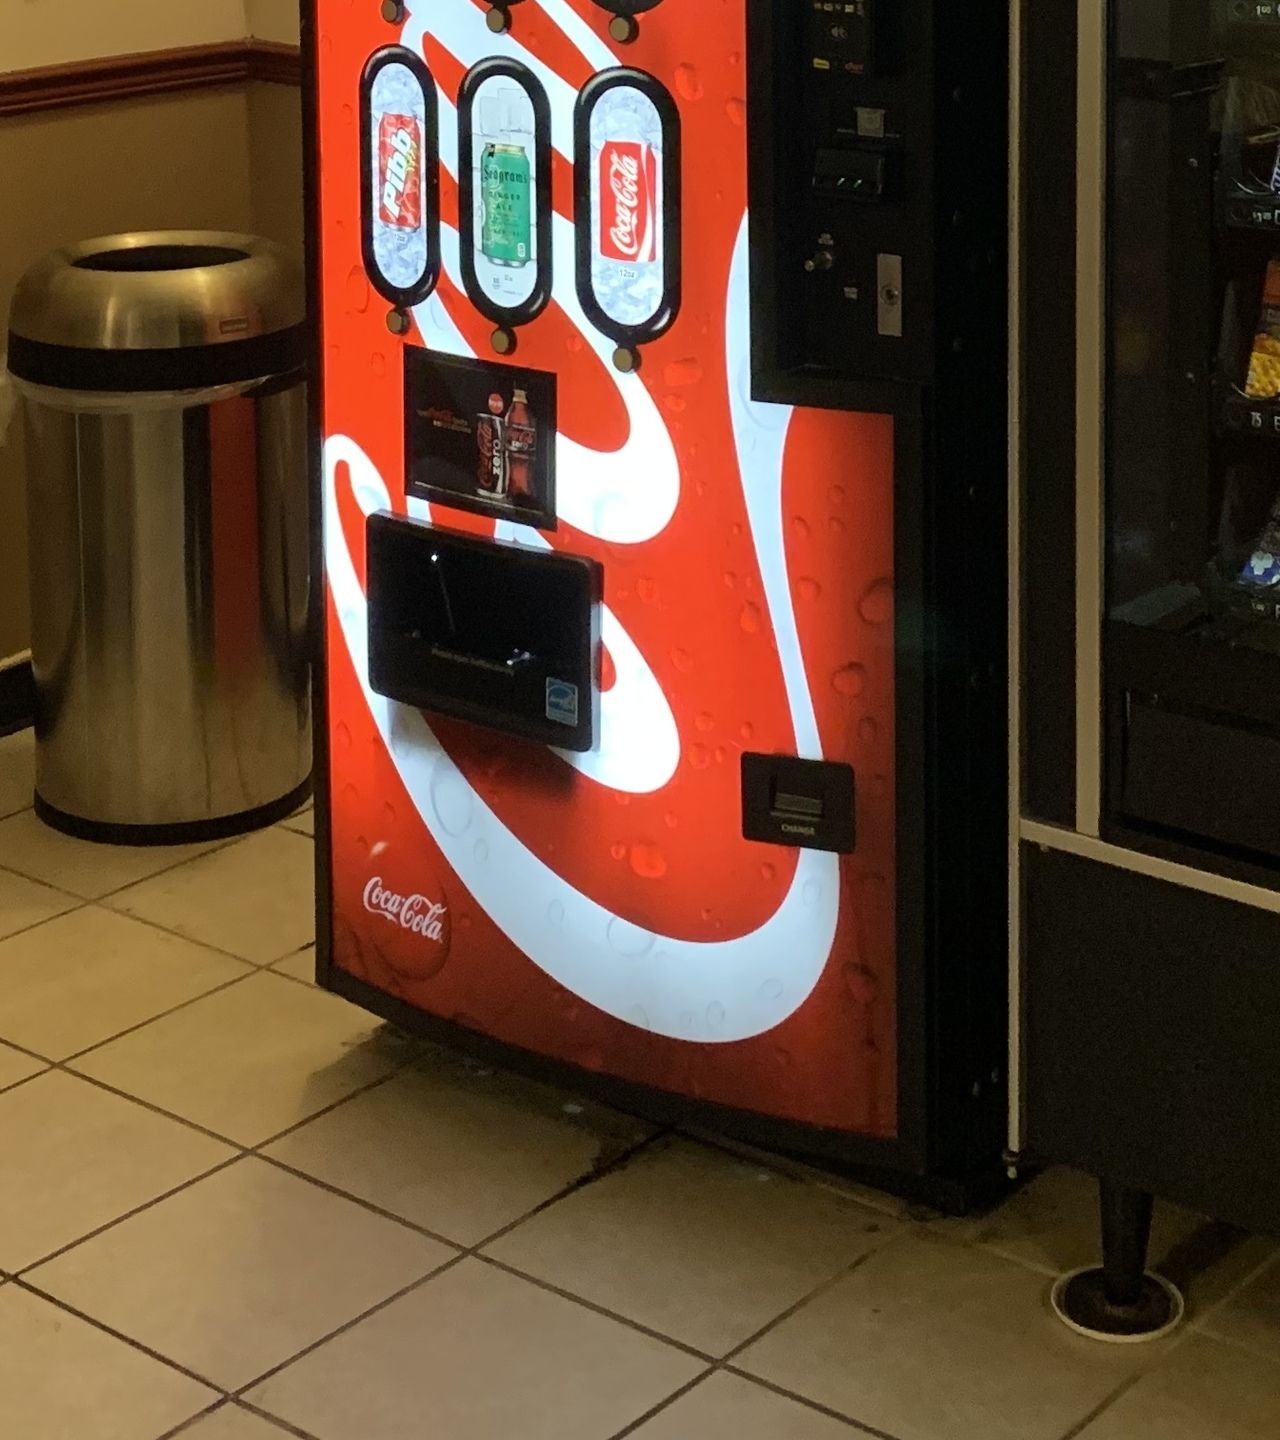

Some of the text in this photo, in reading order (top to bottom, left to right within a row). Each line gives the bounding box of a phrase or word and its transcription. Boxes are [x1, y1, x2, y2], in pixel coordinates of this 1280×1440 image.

[484, 165, 528, 184] Seagram's
[610, 150, 639, 255] Coca-Cola
[492, 439, 502, 475] zero
[363, 876, 447, 943] Coca-Cola
